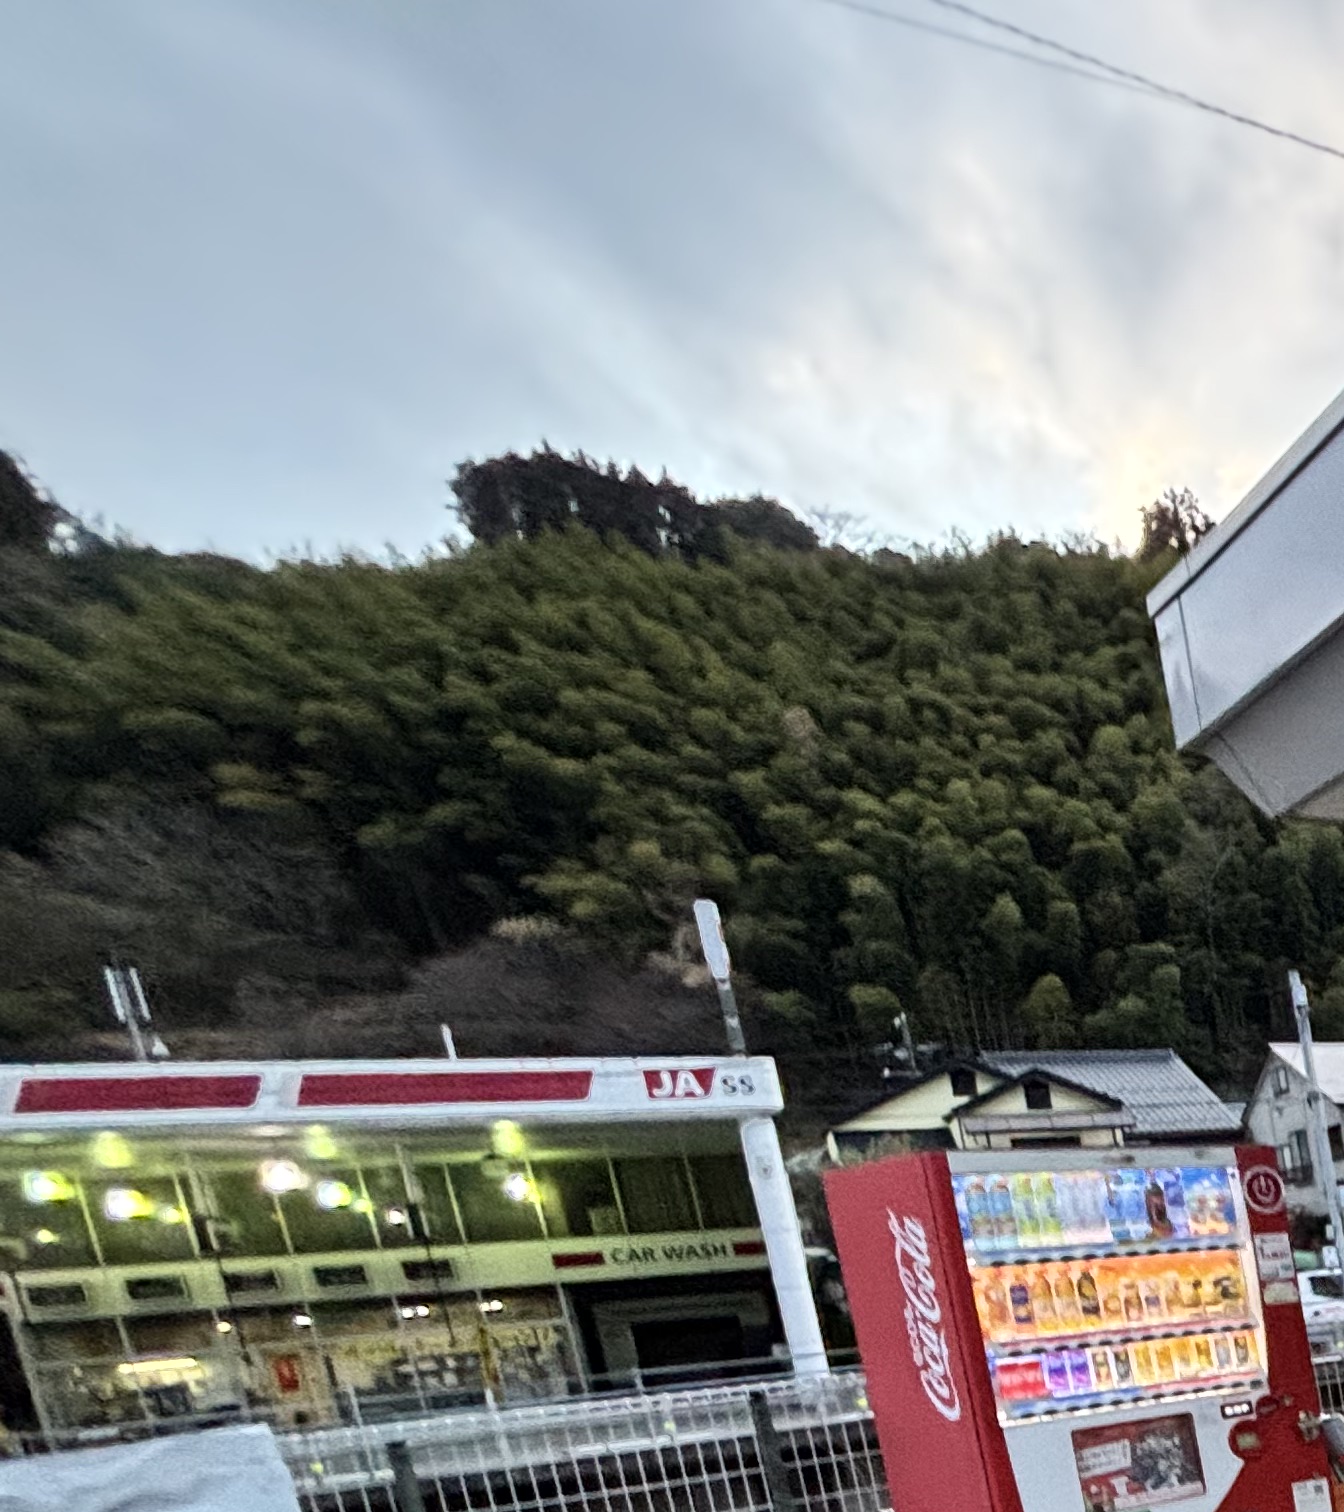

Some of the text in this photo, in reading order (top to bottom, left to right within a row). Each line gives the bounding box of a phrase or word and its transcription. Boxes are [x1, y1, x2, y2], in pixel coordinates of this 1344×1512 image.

[652, 1069, 756, 1097] JA SS
[611, 1243, 728, 1264] CAR WASH
[886, 1206, 961, 1422] Coca-Cola
